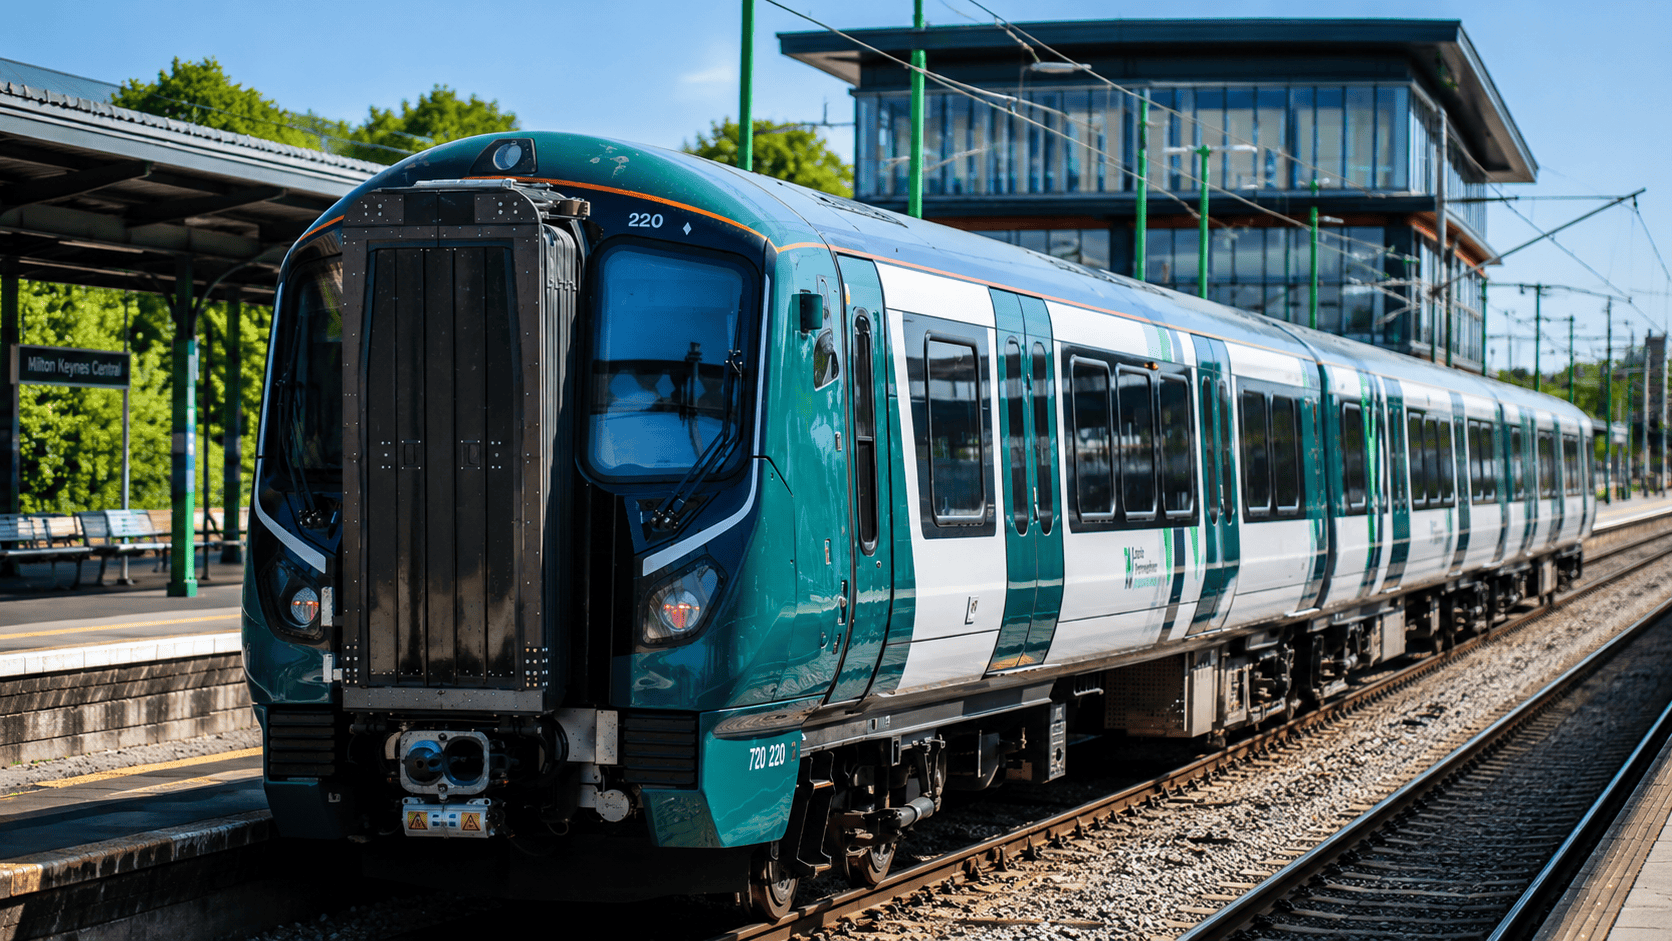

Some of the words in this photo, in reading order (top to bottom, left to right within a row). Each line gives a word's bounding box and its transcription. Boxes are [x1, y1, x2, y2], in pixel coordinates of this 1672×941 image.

[628, 212, 664, 229] 220
[28, 356, 56, 373] Milton
[57, 358, 90, 378] Keynes
[91, 360, 122, 377] Central
[749, 746, 766, 771] 720
[768, 743, 786, 768] 220
